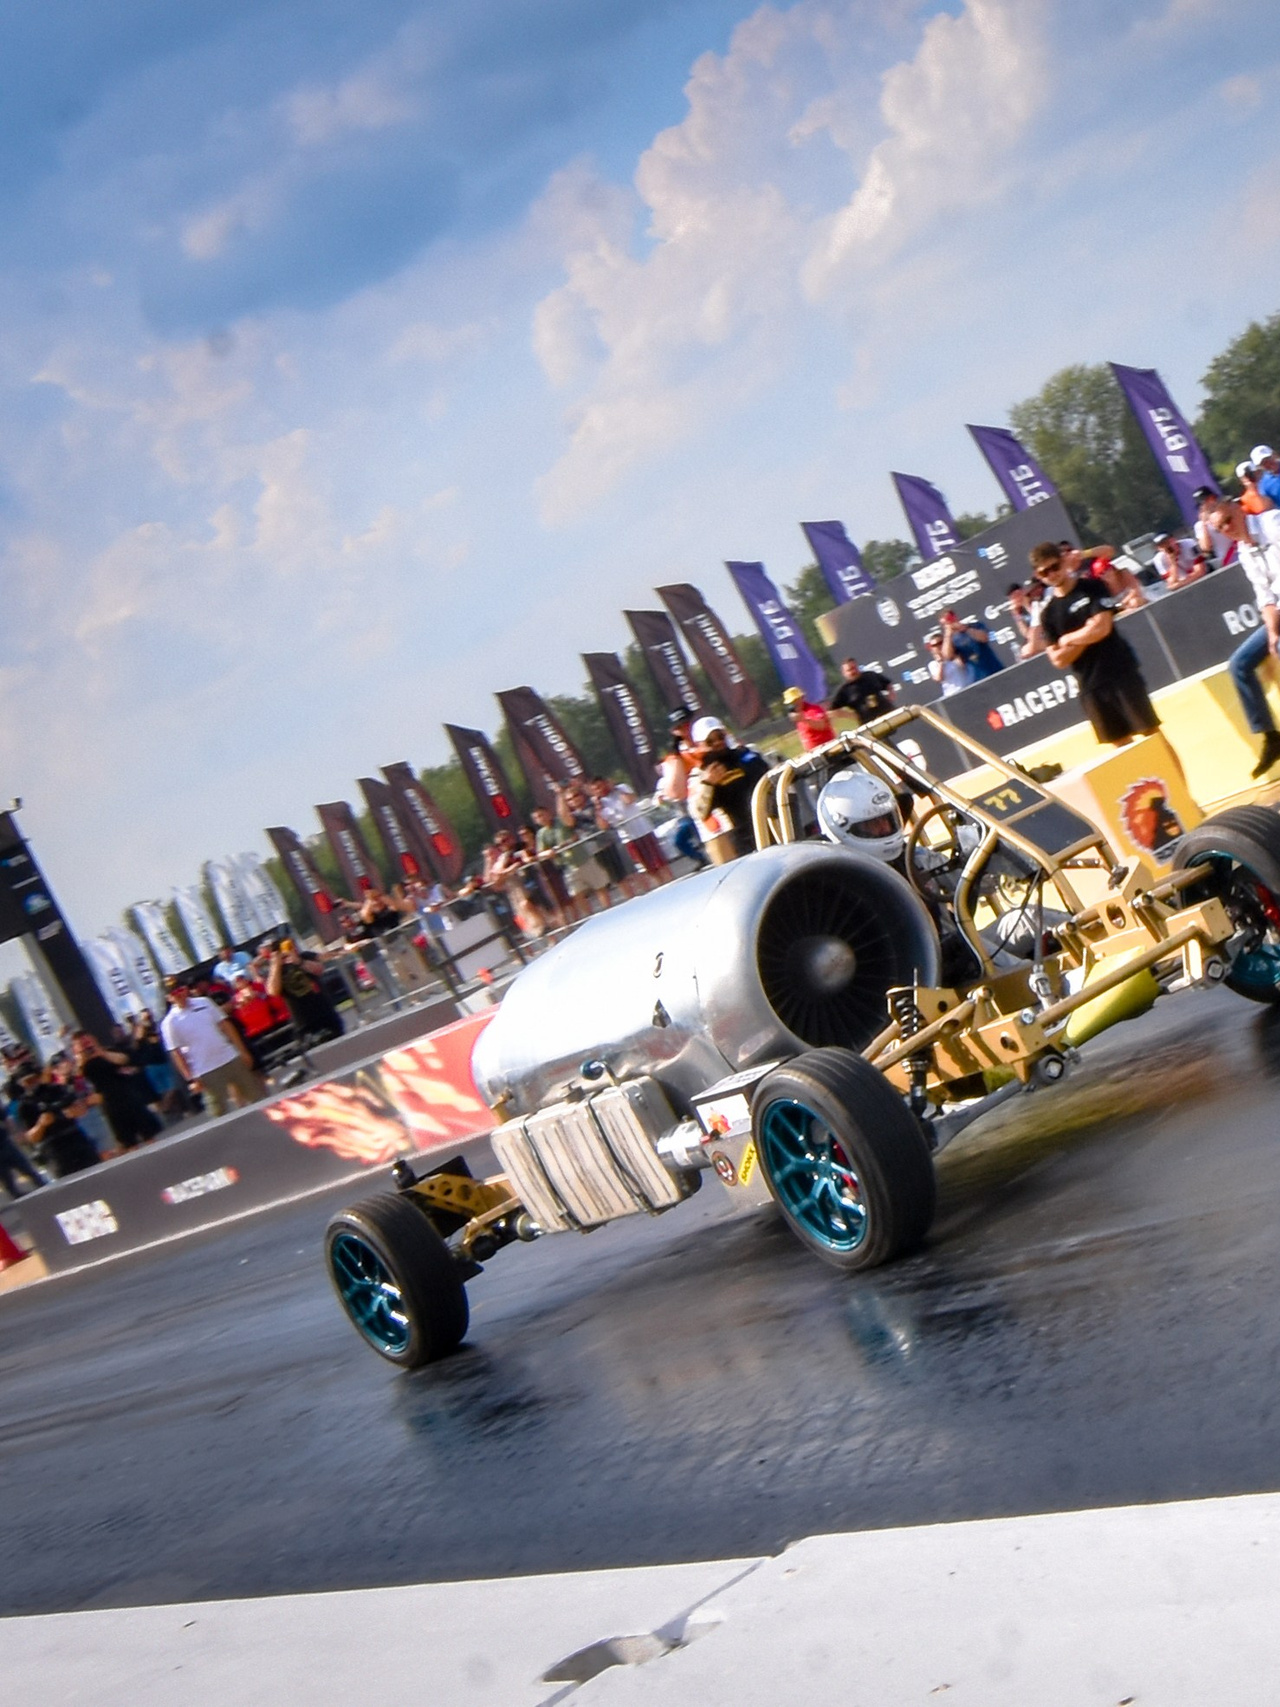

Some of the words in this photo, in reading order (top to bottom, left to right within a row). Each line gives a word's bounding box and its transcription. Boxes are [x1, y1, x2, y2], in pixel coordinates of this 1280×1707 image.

[1148, 407, 1188, 452] ВТБ
[925, 519, 955, 556] ТБ
[837, 565, 870, 601] ТБ
[758, 600, 794, 640] ВТБ
[996, 675, 1080, 727] RACEPA
[983, 788, 1022, 811] 77
